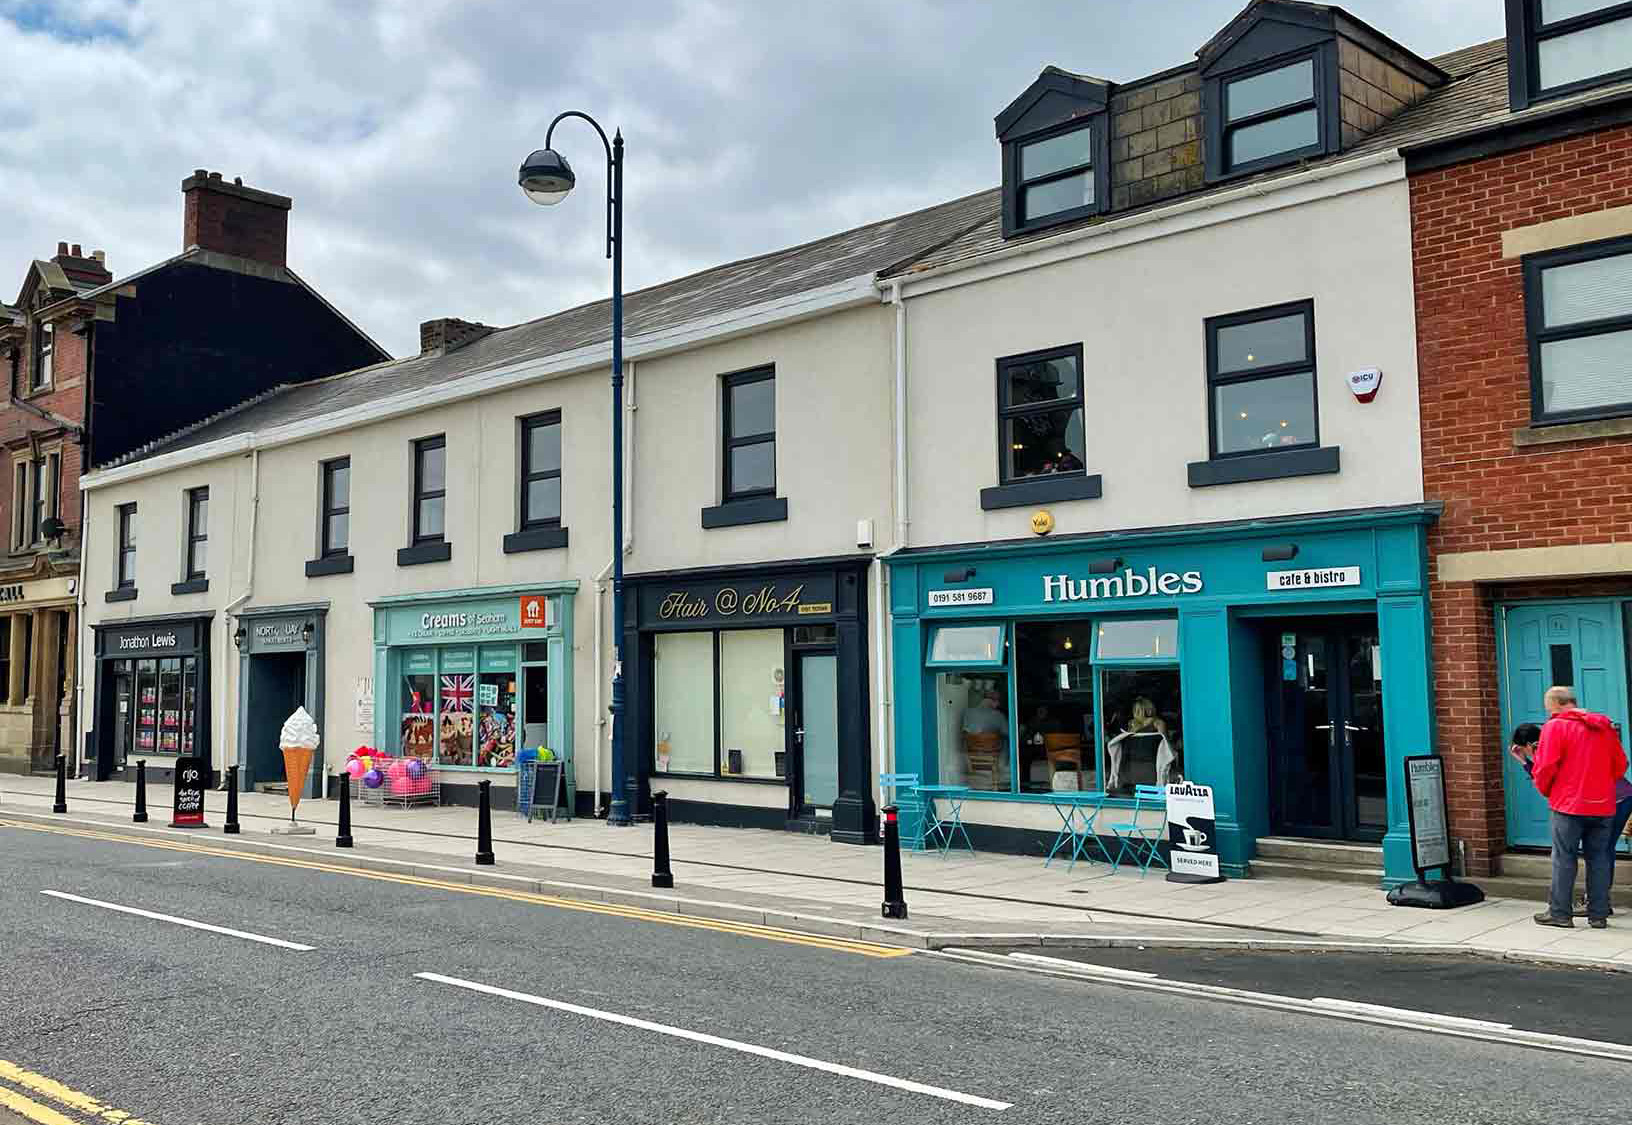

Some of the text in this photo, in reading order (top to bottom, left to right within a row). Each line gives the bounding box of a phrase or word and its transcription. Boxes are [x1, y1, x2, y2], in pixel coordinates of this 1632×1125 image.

[1043, 566, 1203, 602] Humbles
[1279, 571, 1345, 586] cafe & bistro
[659, 592, 710, 619] Hair
[715, 587, 738, 615] @
[934, 592, 986, 602] 0191 581 9687
[422, 613, 466, 629] Creams
[119, 631, 176, 649] Jonathon Lewis
[1169, 785, 1209, 797] LAVAZZA
[1176, 857, 1213, 867] SERVED HERE
